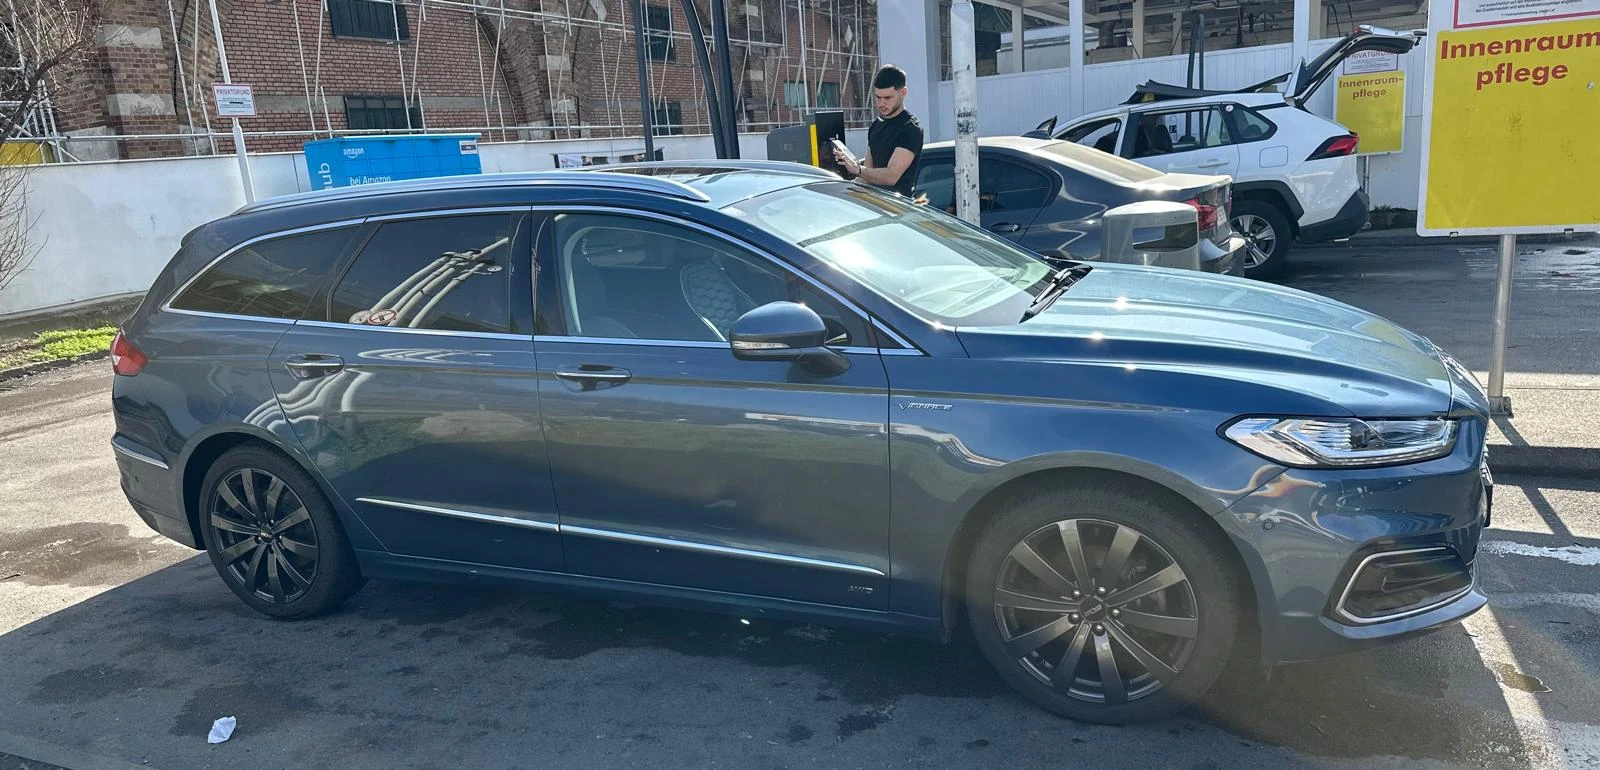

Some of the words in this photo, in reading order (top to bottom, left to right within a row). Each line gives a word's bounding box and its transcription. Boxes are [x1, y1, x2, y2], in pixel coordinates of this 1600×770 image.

[1338, 77, 1403, 88] Innenraum-
[1476, 62, 1569, 91] pflege
[1352, 88, 1386, 100] pflege
[343, 147, 365, 156] amazon
[349, 176, 361, 187] bei
[362, 175, 391, 185] Amazon
